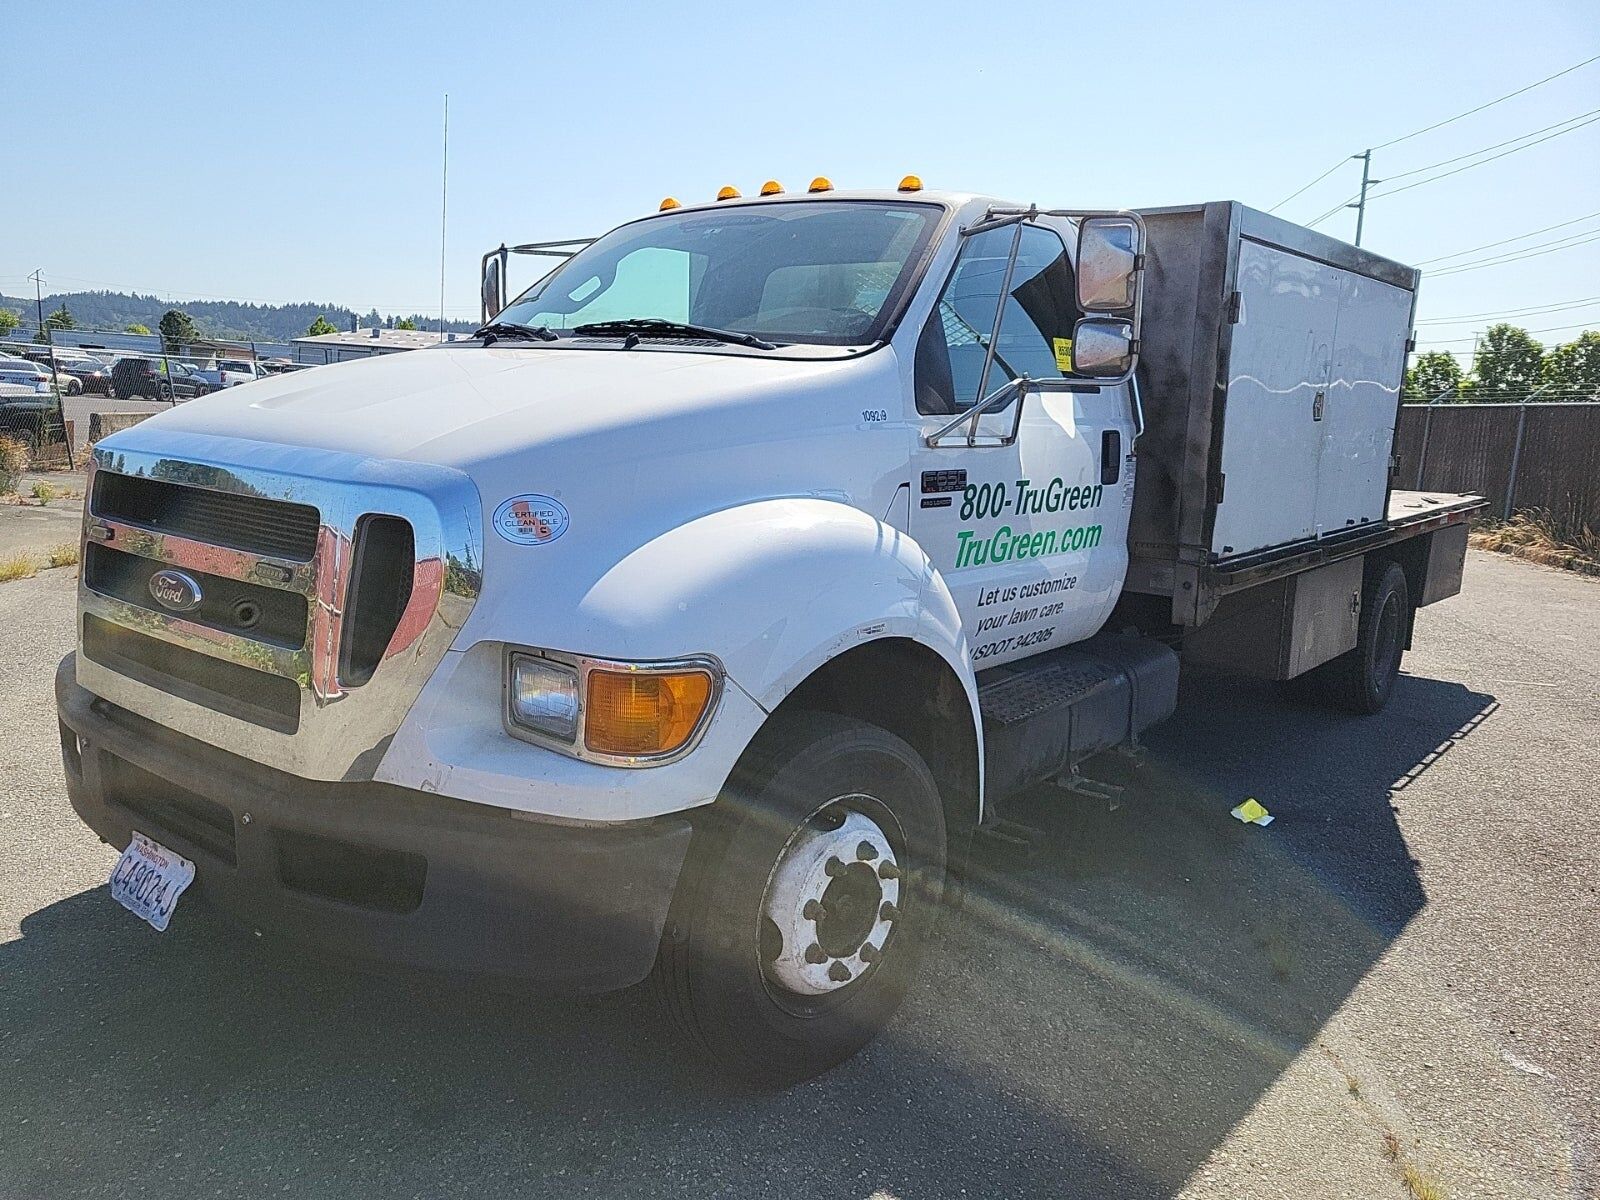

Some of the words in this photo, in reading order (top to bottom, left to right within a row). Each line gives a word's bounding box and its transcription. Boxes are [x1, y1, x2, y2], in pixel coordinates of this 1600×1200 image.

[508, 510, 554, 519] CERTIFIED
[960, 478, 1103, 521] 800-TruGreen
[540, 518, 559, 526] IDLE
[955, 524, 1102, 568] TruGreen.com
[156, 576, 184, 603] Ford
[977, 587, 1000, 607] Let
[1002, 587, 1018, 603] us
[1019, 572, 1077, 599] customize
[975, 613, 1009, 638] your
[1007, 607, 1038, 626] lawn
[1039, 602, 1064, 618] care.
[1012, 627, 1056, 650] 342305
[114, 855, 181, 917] C49024J
